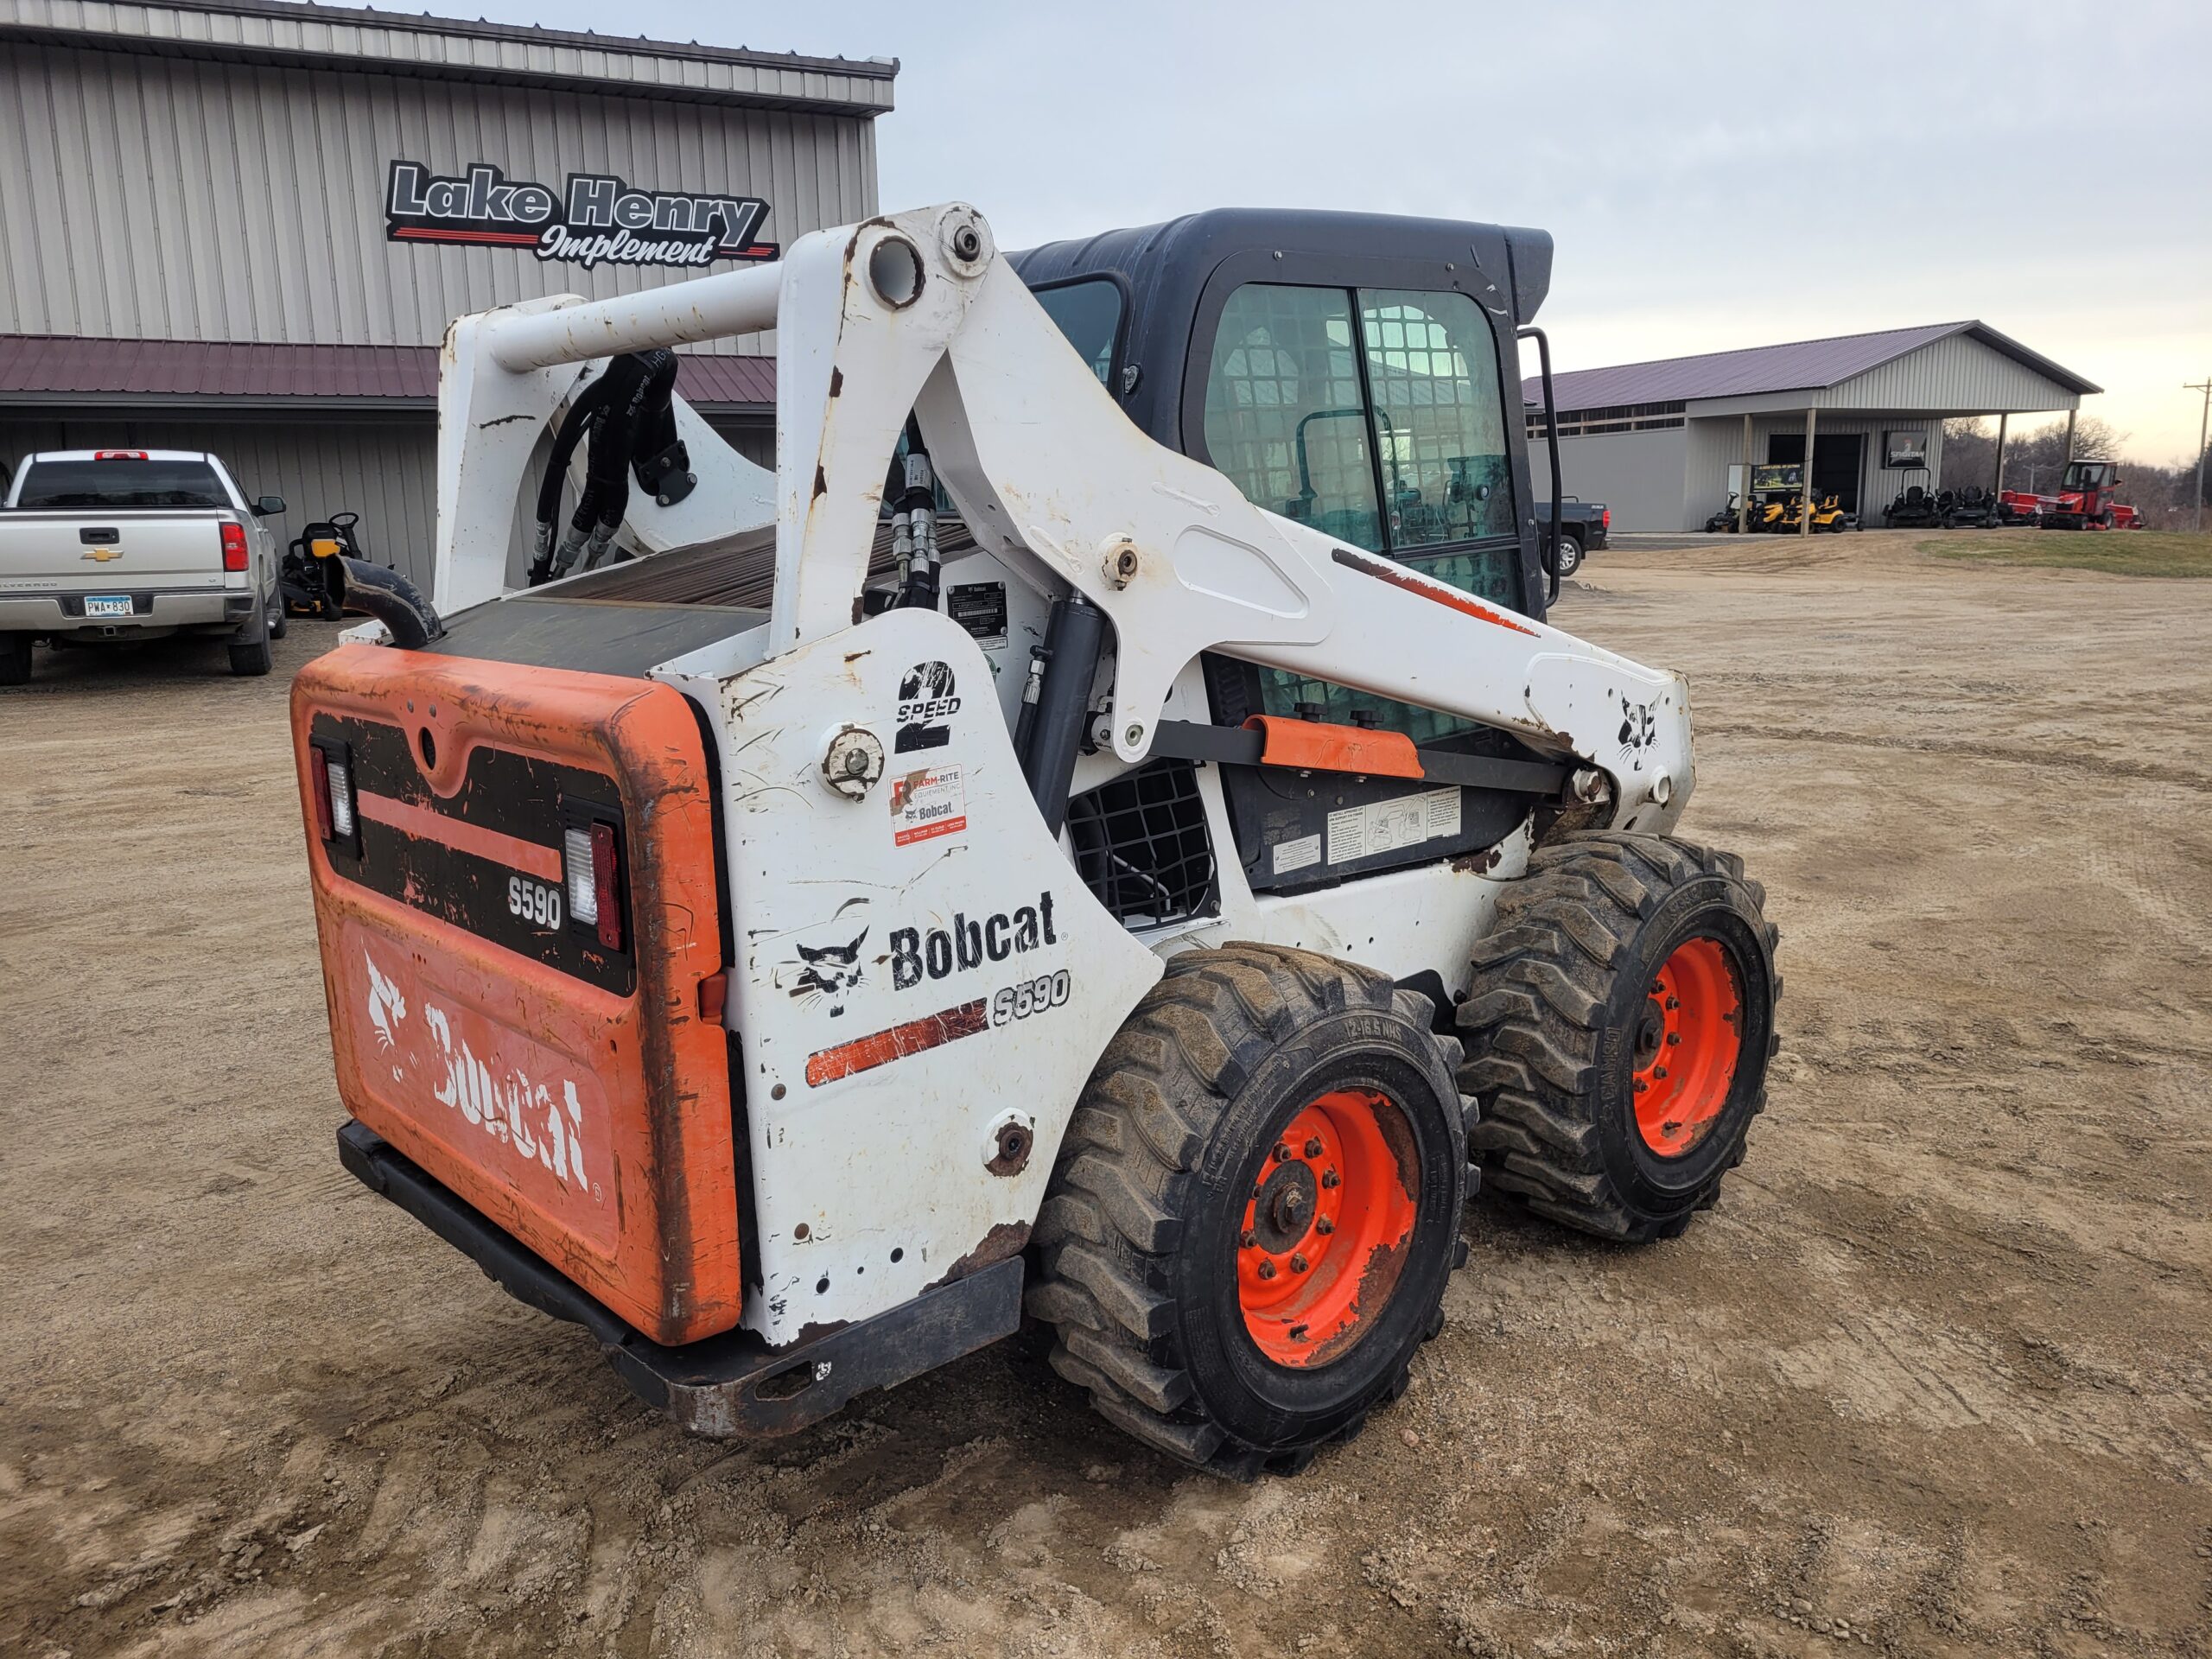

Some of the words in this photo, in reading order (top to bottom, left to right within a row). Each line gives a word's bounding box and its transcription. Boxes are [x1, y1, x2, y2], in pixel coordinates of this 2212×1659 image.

[391, 165, 551, 223] Lake
[568, 178, 760, 247] Henry
[536, 224, 717, 265] Implement
[87, 601, 105, 612] PWA
[112, 601, 130, 612] 830
[896, 697, 962, 723] SPEED
[912, 771, 959, 790] FARM-RITE
[918, 801, 953, 820] Bobcat
[508, 876, 562, 931] S590
[889, 891, 1057, 991] Bobcat
[993, 969, 1071, 1027] S590
